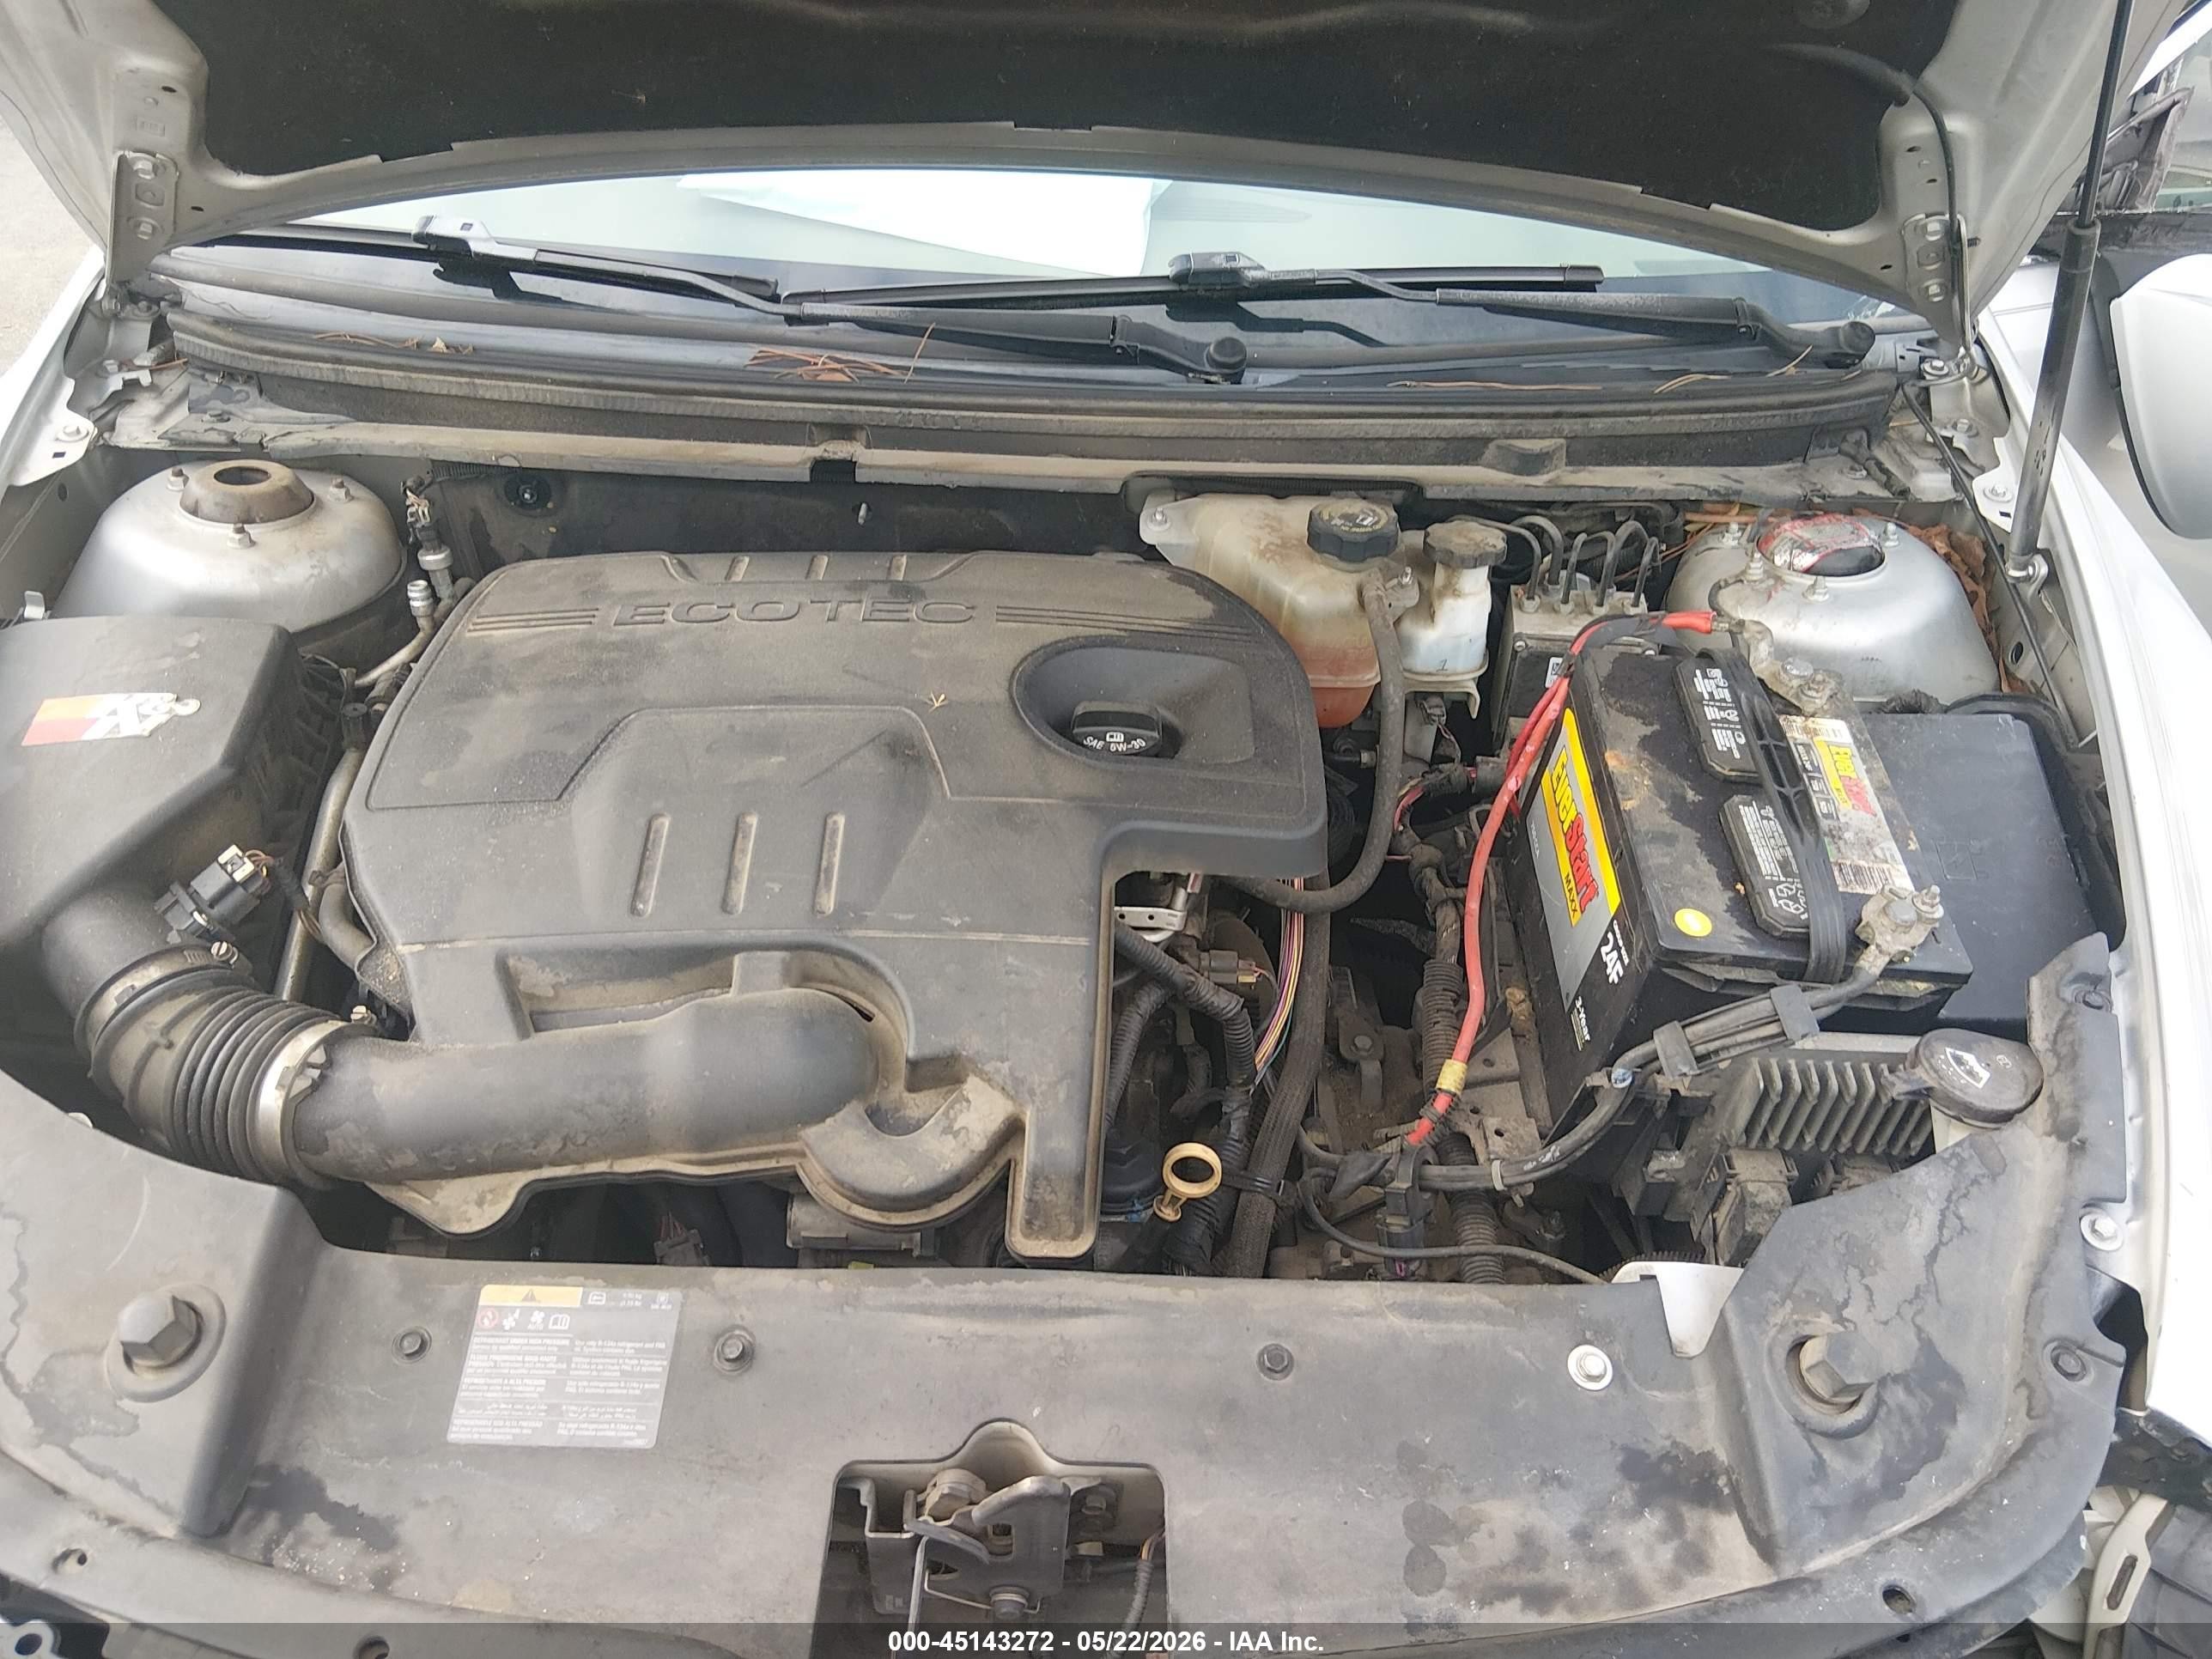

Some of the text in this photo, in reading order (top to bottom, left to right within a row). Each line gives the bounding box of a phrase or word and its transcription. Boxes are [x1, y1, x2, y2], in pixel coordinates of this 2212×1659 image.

[612, 599, 976, 626] ECOTEC
[1083, 736, 1105, 750] SAE
[1551, 747, 1599, 914] EverStart
[1564, 873, 1579, 919] MAXX
[1600, 931, 1624, 985] 24F
[1574, 995, 1591, 1042] 3-Year
